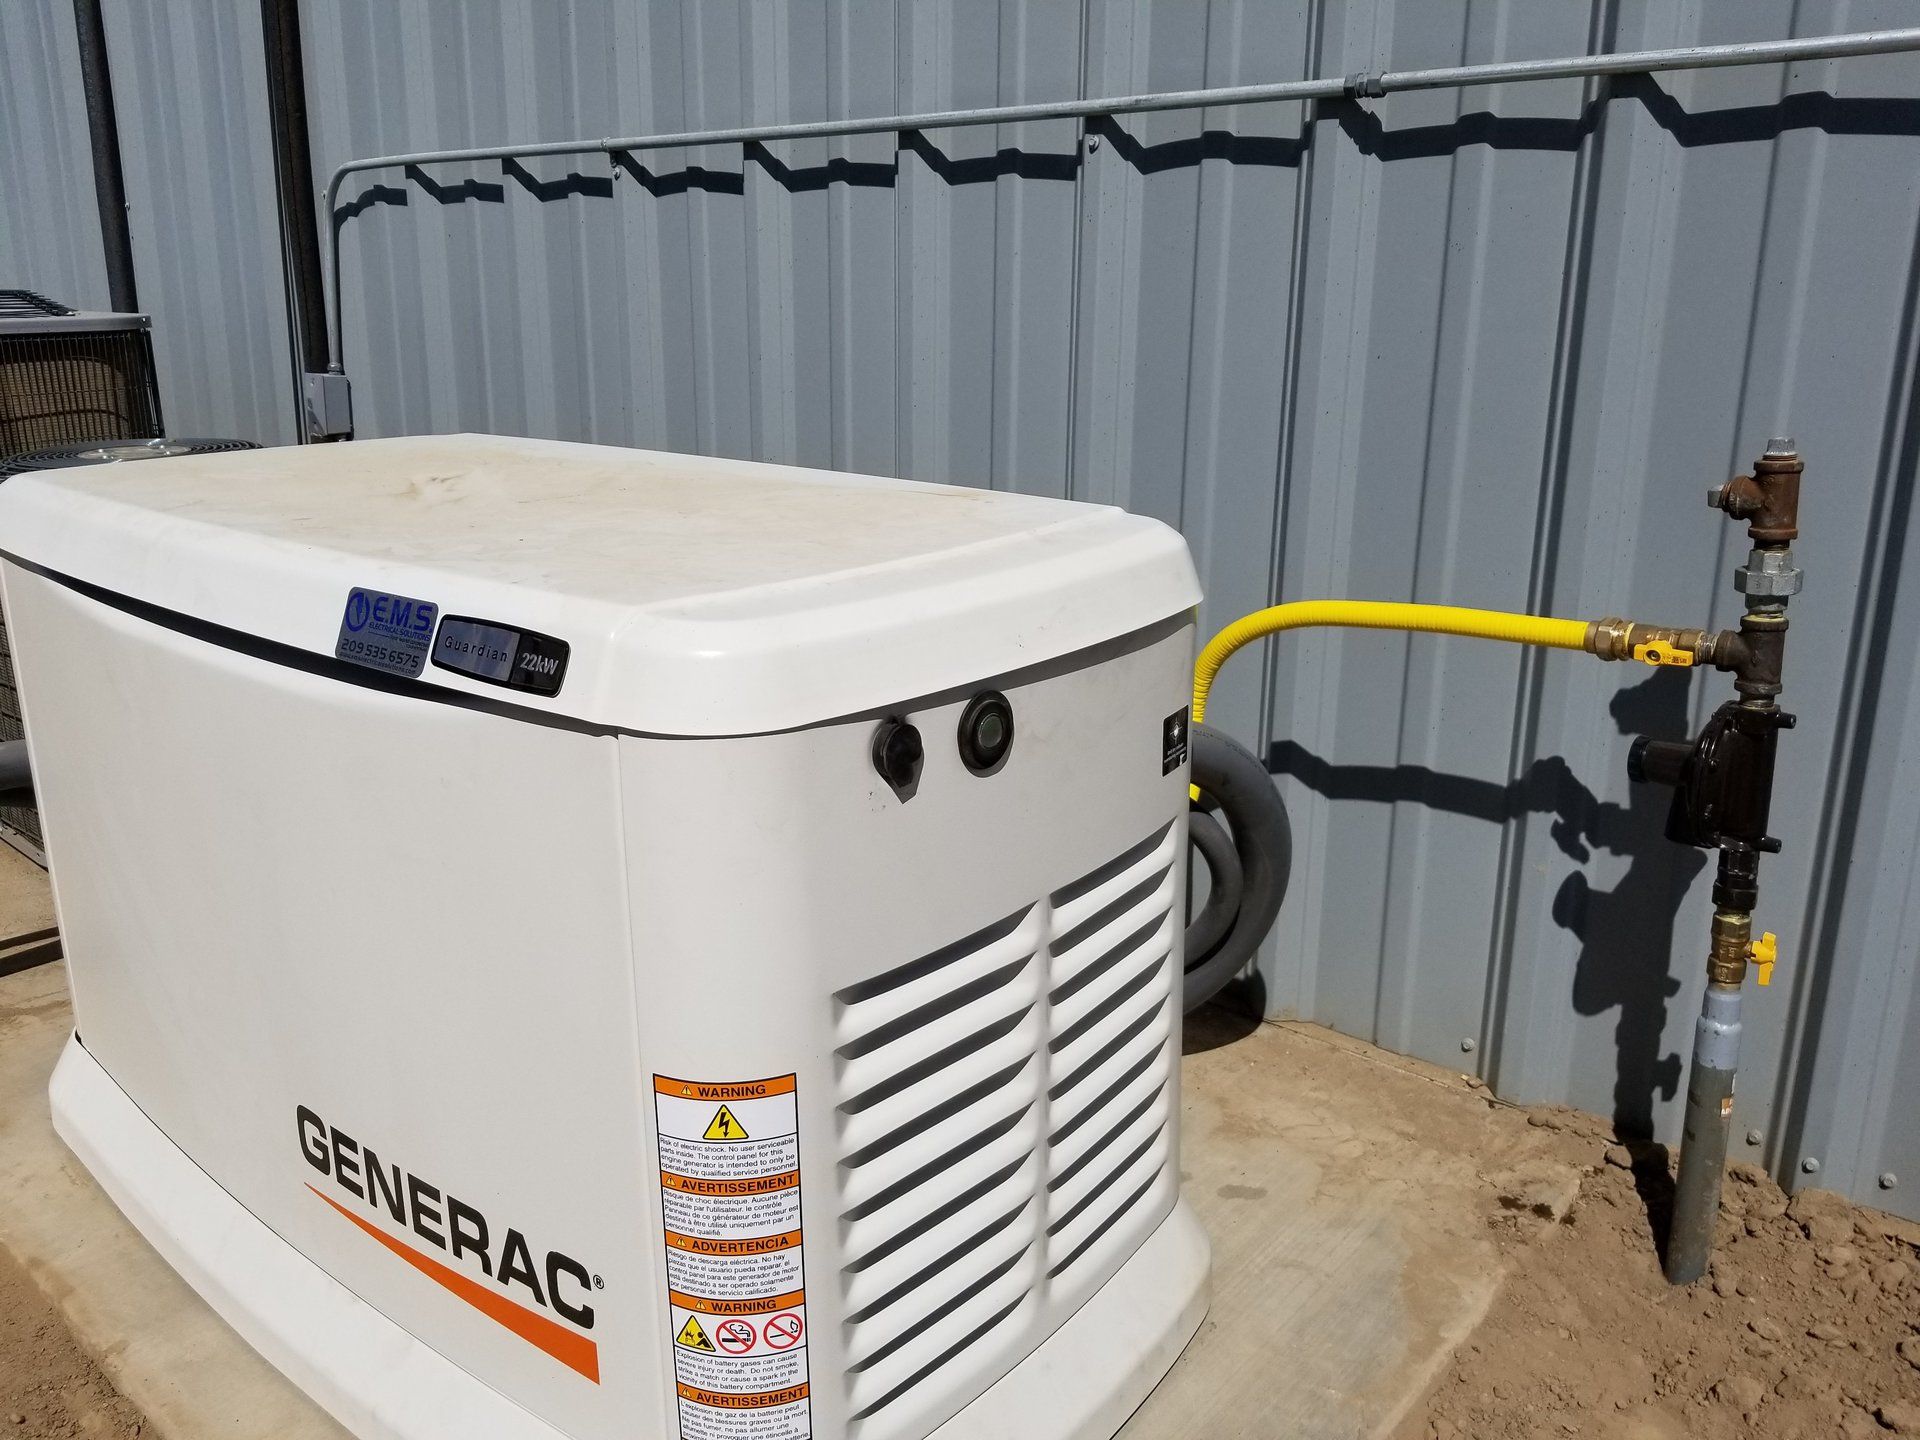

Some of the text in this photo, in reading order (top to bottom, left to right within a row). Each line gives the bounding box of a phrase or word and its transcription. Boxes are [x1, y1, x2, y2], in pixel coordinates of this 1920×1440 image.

[373, 596, 432, 633] E.M.S.
[369, 622, 430, 641] ELECTRICAL SOLUTIONS
[341, 639, 419, 667] 209 535 6575
[445, 636, 508, 662] Guardian
[520, 653, 559, 675] 22kW
[698, 1085, 766, 1097] WARNING
[681, 1143, 702, 1151] electric
[758, 1138, 794, 1150] serviceable
[661, 1147, 674, 1155] parts
[676, 1150, 695, 1158] inside.
[737, 1153, 757, 1161] panel
[662, 1155, 681, 1165] engine
[683, 1160, 716, 1169] generator
[769, 1156, 784, 1165] only
[662, 1162, 689, 1173] operated
[691, 1168, 699, 1176] by
[761, 1161, 797, 1174] personnel.
[681, 1174, 795, 1193] AVERTISSEMENT
[664, 1189, 684, 1200] Risque
[714, 1198, 749, 1206] électrique.
[752, 1195, 778, 1203] Aucune
[780, 1189, 798, 1199] pièce
[665, 1205, 690, 1217] Panneau
[712, 1214, 749, 1222] générateur
[762, 1208, 787, 1218] moteur
[788, 1204, 799, 1212] est
[694, 1205, 704, 1213] par
[754, 1201, 782, 1211] contrôle
[297, 1105, 594, 1330] GENERAC
[730, 1219, 770, 1228] uniquement
[773, 1217, 784, 1225] par
[666, 1222, 695, 1233] personnel
[692, 1237, 788, 1252] ADVERTENCIA
[698, 1257, 728, 1266] descarga
[774, 1254, 785, 1262] hay
[669, 1265, 687, 1275] control
[689, 1271, 705, 1279] panel
[738, 1272, 770, 1281] generador
[782, 1266, 800, 1274] motor
[734, 1266, 755, 1275] pueda
[681, 1282, 706, 1294] personal
[682, 1276, 710, 1287] destinado
[760, 1275, 794, 1286] solamente
[711, 1300, 777, 1313] WARNING
[676, 1350, 705, 1364] Explosion
[715, 1360, 738, 1368] battery
[778, 1354, 797, 1362] cause
[678, 1359, 696, 1368] severe
[698, 1364, 714, 1373] injury
[678, 1366, 693, 1375] strike
[700, 1372, 719, 1381] match
[759, 1374, 778, 1382] spark
[679, 1374, 697, 1385] vicinity
[745, 1379, 792, 1390] compartment.
[697, 1388, 804, 1406] AVERTISSEMENT
[758, 1408, 783, 1417] batterie
[785, 1404, 799, 1413] peut
[749, 1418, 771, 1426] graves
[717, 1432, 749, 1440] provoquer
[766, 1429, 792, 1438] étincelle
